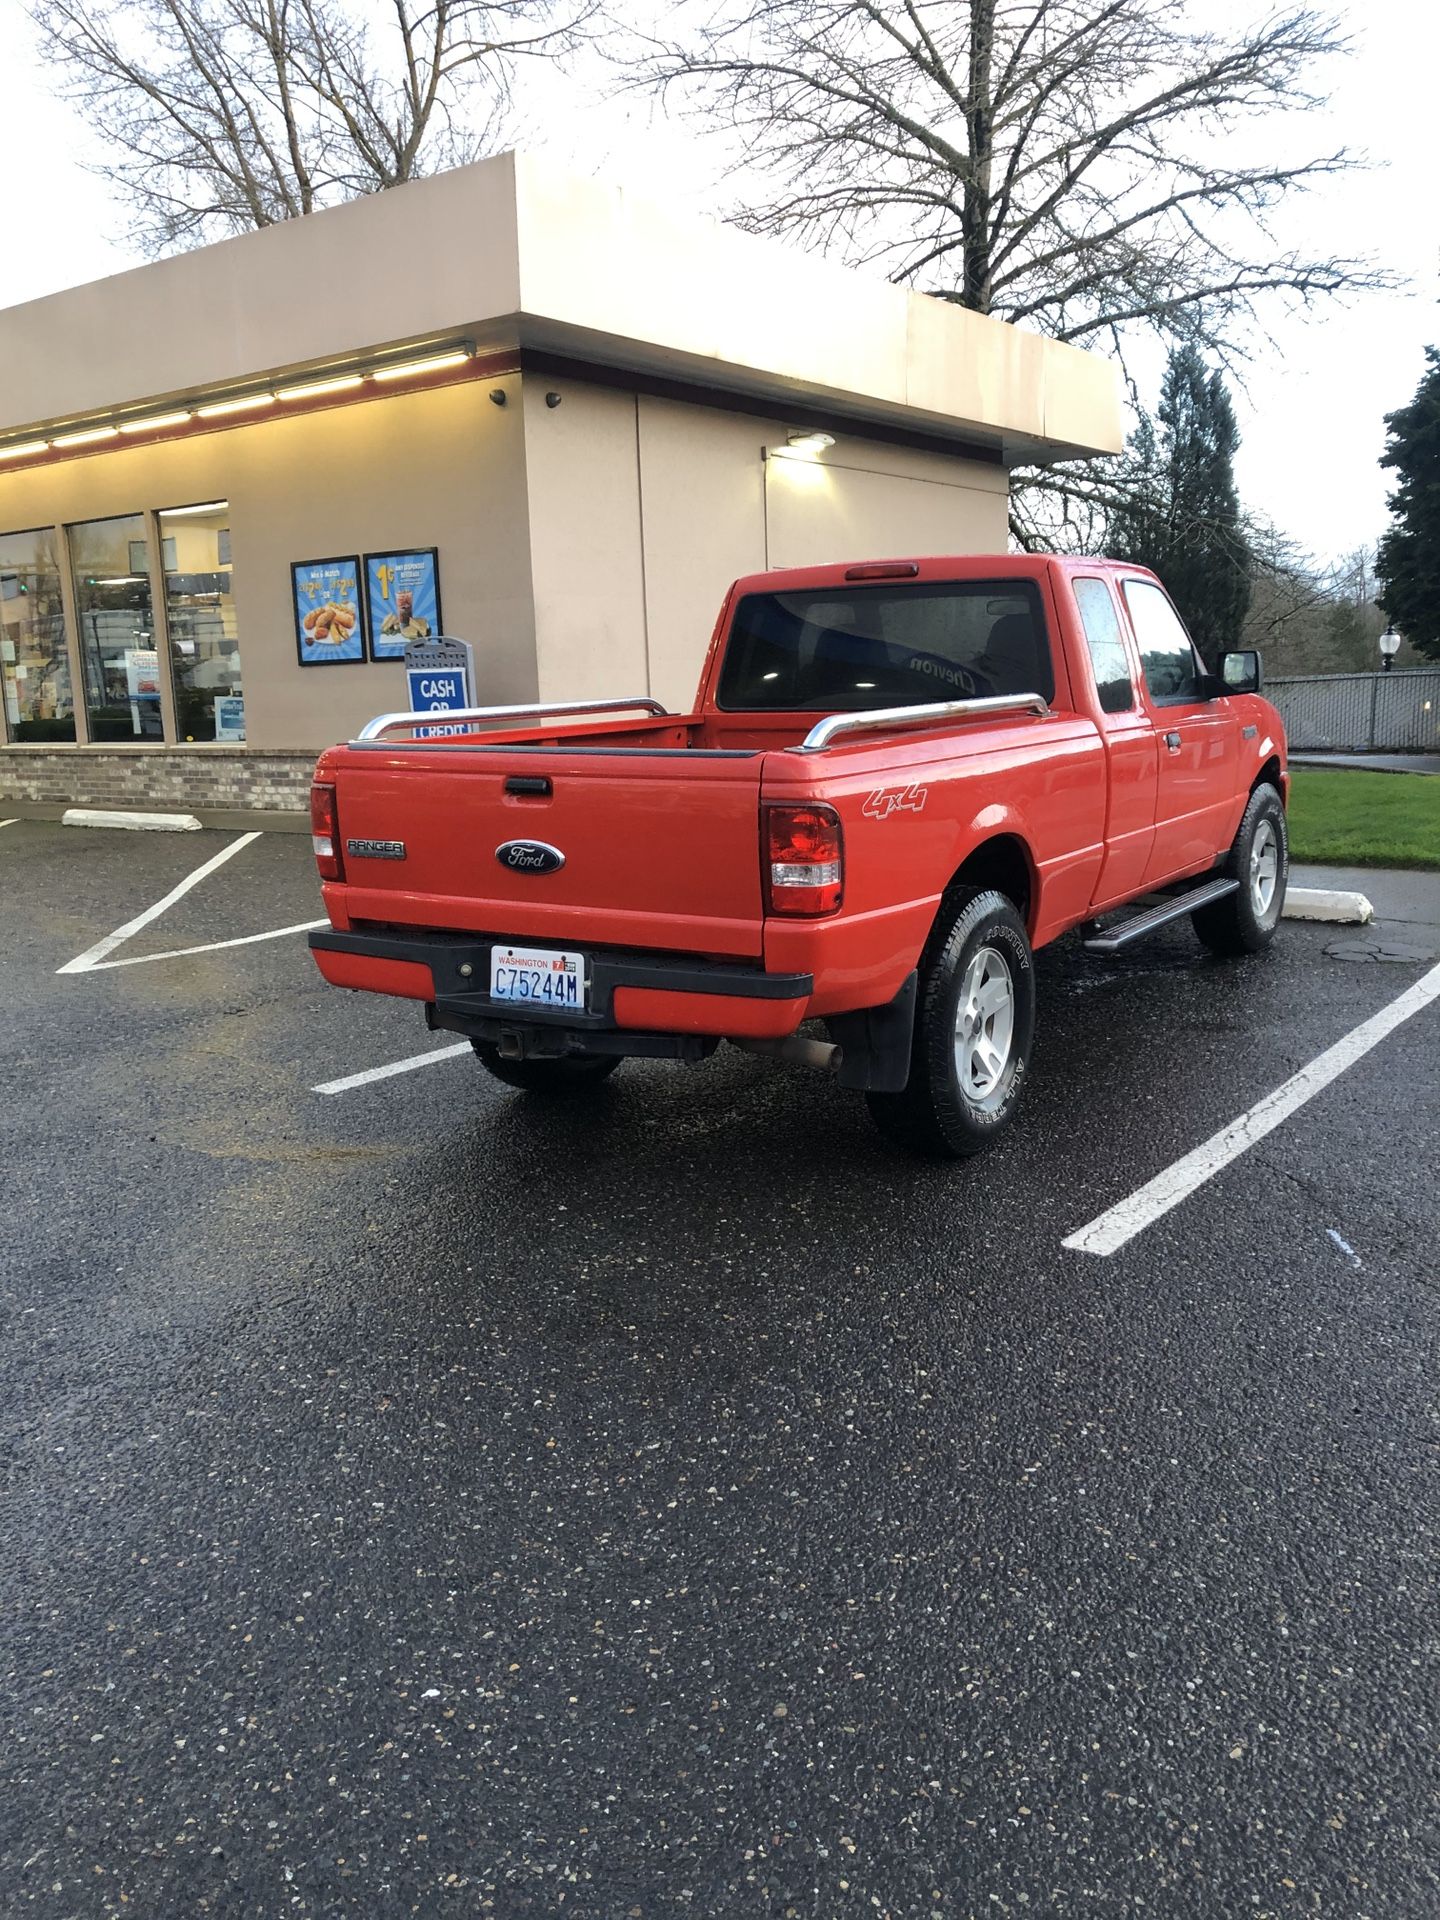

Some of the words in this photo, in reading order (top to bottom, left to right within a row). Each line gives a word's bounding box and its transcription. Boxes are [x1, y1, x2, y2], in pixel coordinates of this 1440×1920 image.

[420, 679, 456, 698] CASH
[419, 724, 465, 738] CREDIT
[862, 781, 928, 820] 4x4
[347, 839, 404, 853] RANGER
[507, 845, 545, 867] Ford
[985, 925, 1030, 969] COUNTRY
[498, 956, 548, 968] WASHINGTON
[496, 968, 577, 1003] C75244M
[1005, 1056, 1025, 1099] ALL
